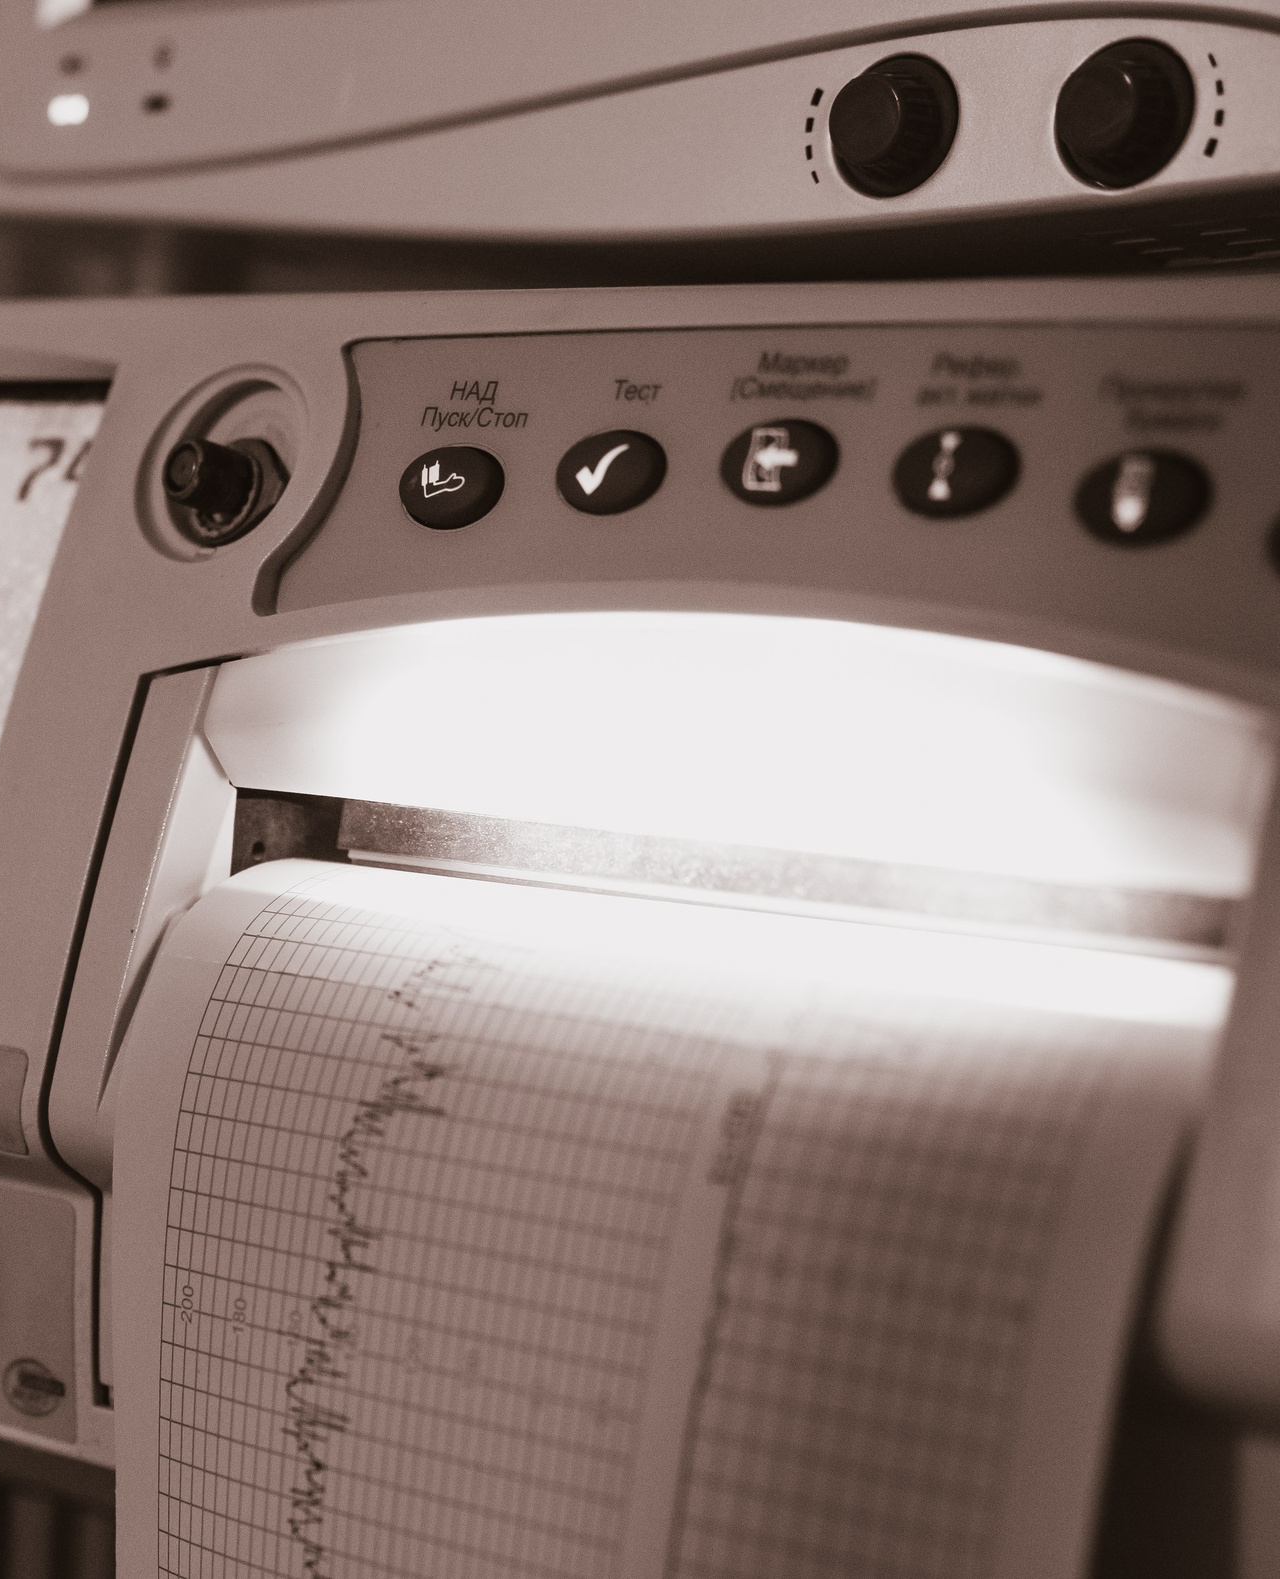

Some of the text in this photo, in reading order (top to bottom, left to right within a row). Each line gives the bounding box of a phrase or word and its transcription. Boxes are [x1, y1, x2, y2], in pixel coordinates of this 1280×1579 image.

[450, 380, 498, 405] НАД
[613, 379, 662, 402] Тест
[420, 406, 529, 430] Пуск/Стоп
[180, 1285, 195, 1324] 200
